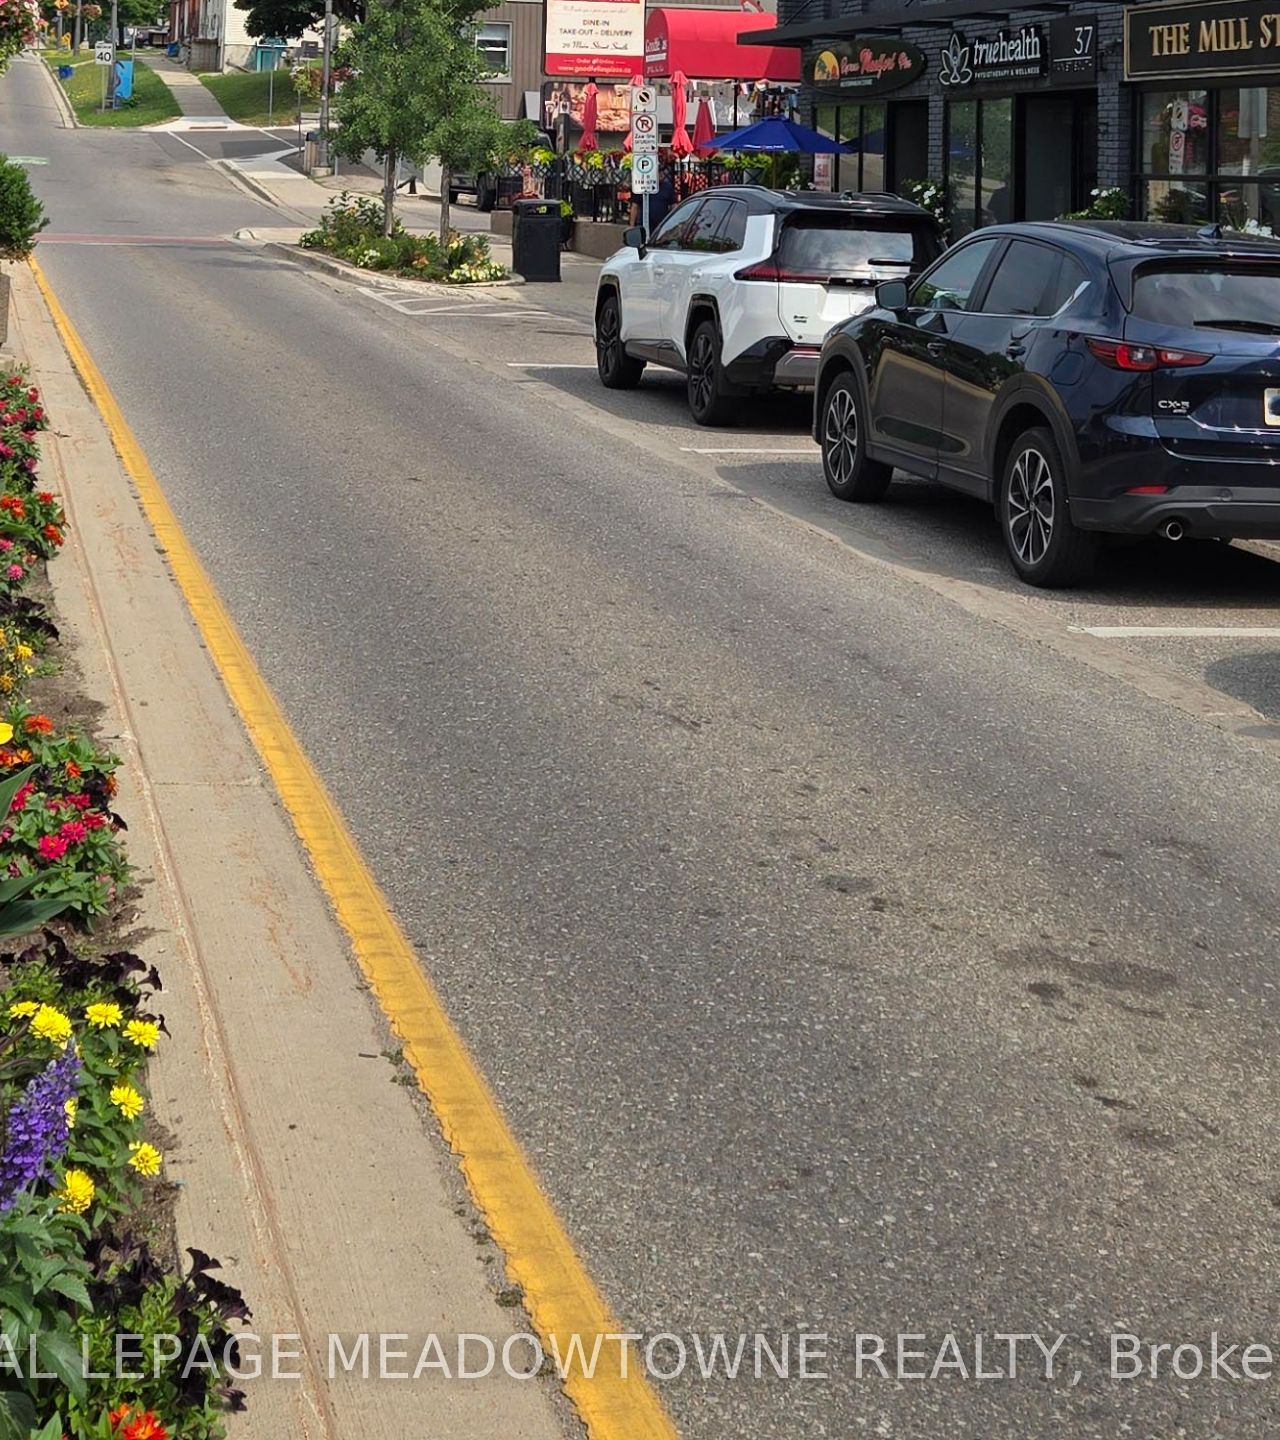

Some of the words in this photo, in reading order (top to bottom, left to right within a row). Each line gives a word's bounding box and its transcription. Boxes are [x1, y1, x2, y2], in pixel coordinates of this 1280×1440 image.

[1074, 26, 1093, 54] 37
[1148, 23, 1190, 56] THE
[1198, 18, 1253, 52] MILL
[96, 52, 112, 61] 40
[1158, 400, 1190, 409] CX-5
